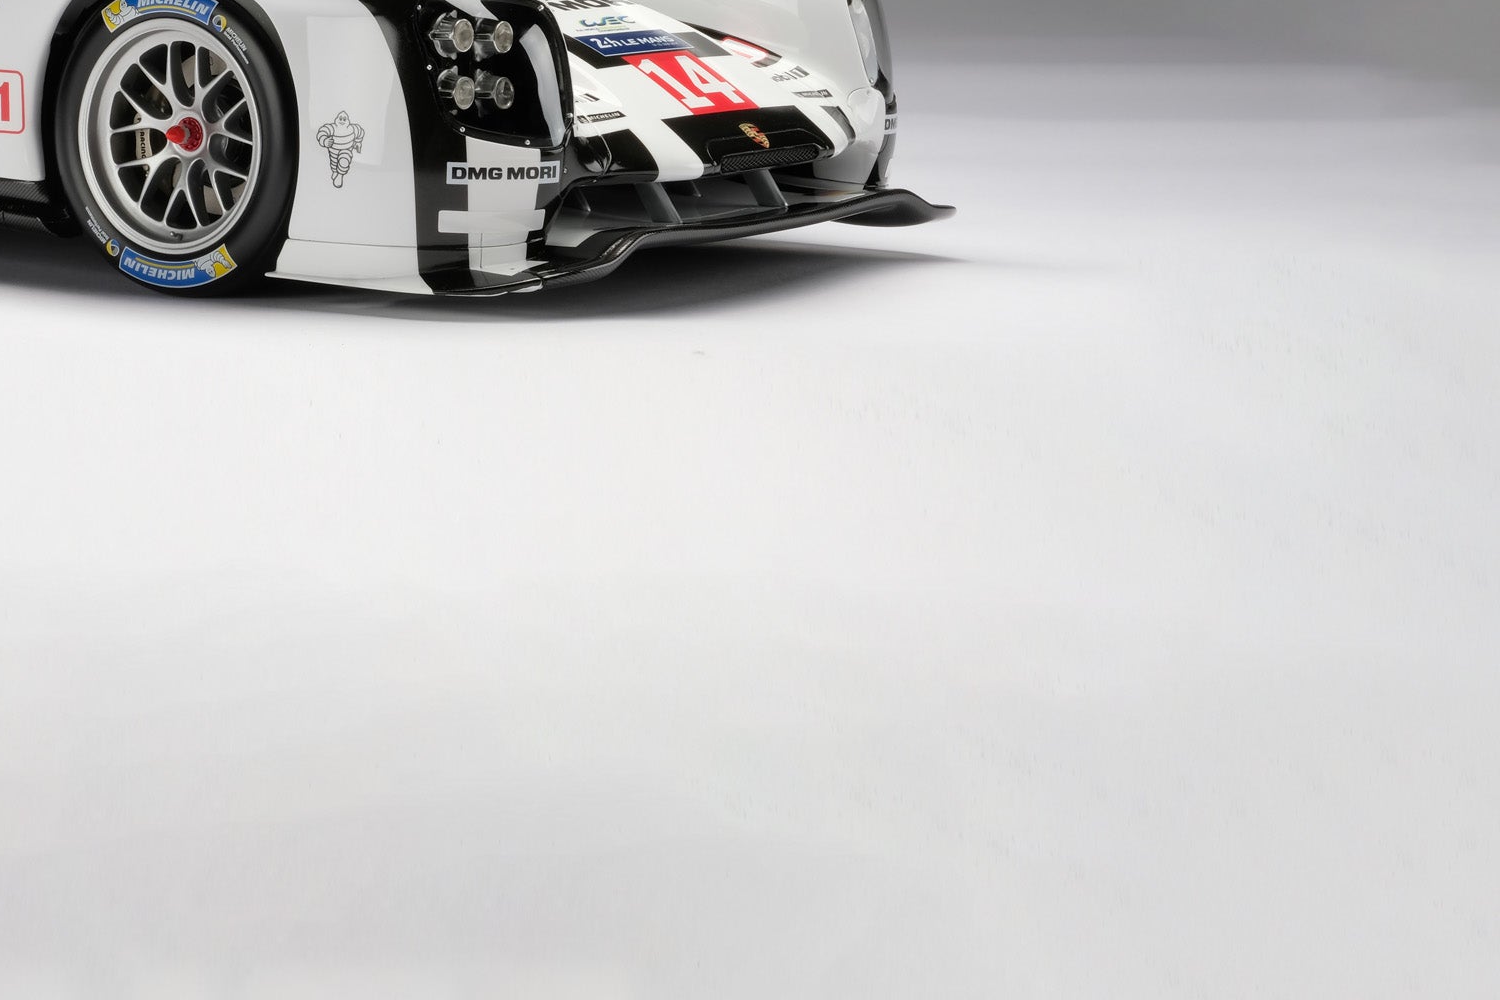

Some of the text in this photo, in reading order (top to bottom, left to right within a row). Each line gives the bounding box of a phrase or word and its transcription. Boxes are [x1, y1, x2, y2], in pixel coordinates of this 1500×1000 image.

[580, 15, 636, 28] WEC
[621, 38, 640, 46] LE
[639, 35, 674, 45] MANS
[637, 55, 745, 108] 14
[451, 165, 557, 180] DMG MORI
[124, 256, 195, 280] MICHELIN
